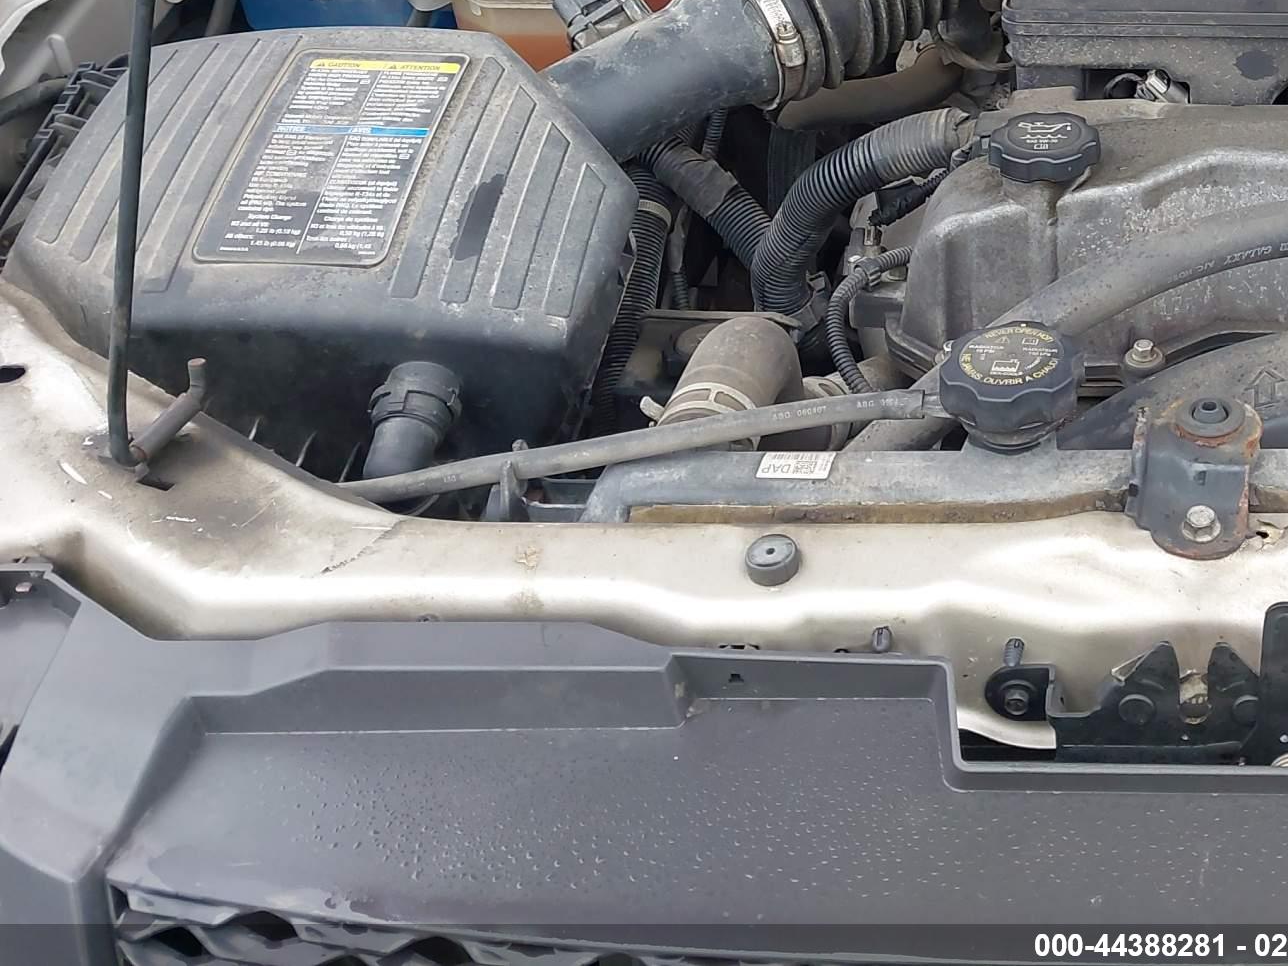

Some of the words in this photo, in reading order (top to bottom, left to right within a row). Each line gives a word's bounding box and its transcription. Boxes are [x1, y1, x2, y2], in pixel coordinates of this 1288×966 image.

[277, 125, 306, 133] NOTICE
[1224, 245, 1273, 266] GALAXY
[985, 328, 1014, 339] NEVER
[1015, 328, 1036, 337] OPEN
[983, 377, 1024, 386] OUVRIR
[761, 463, 792, 475] DAP
